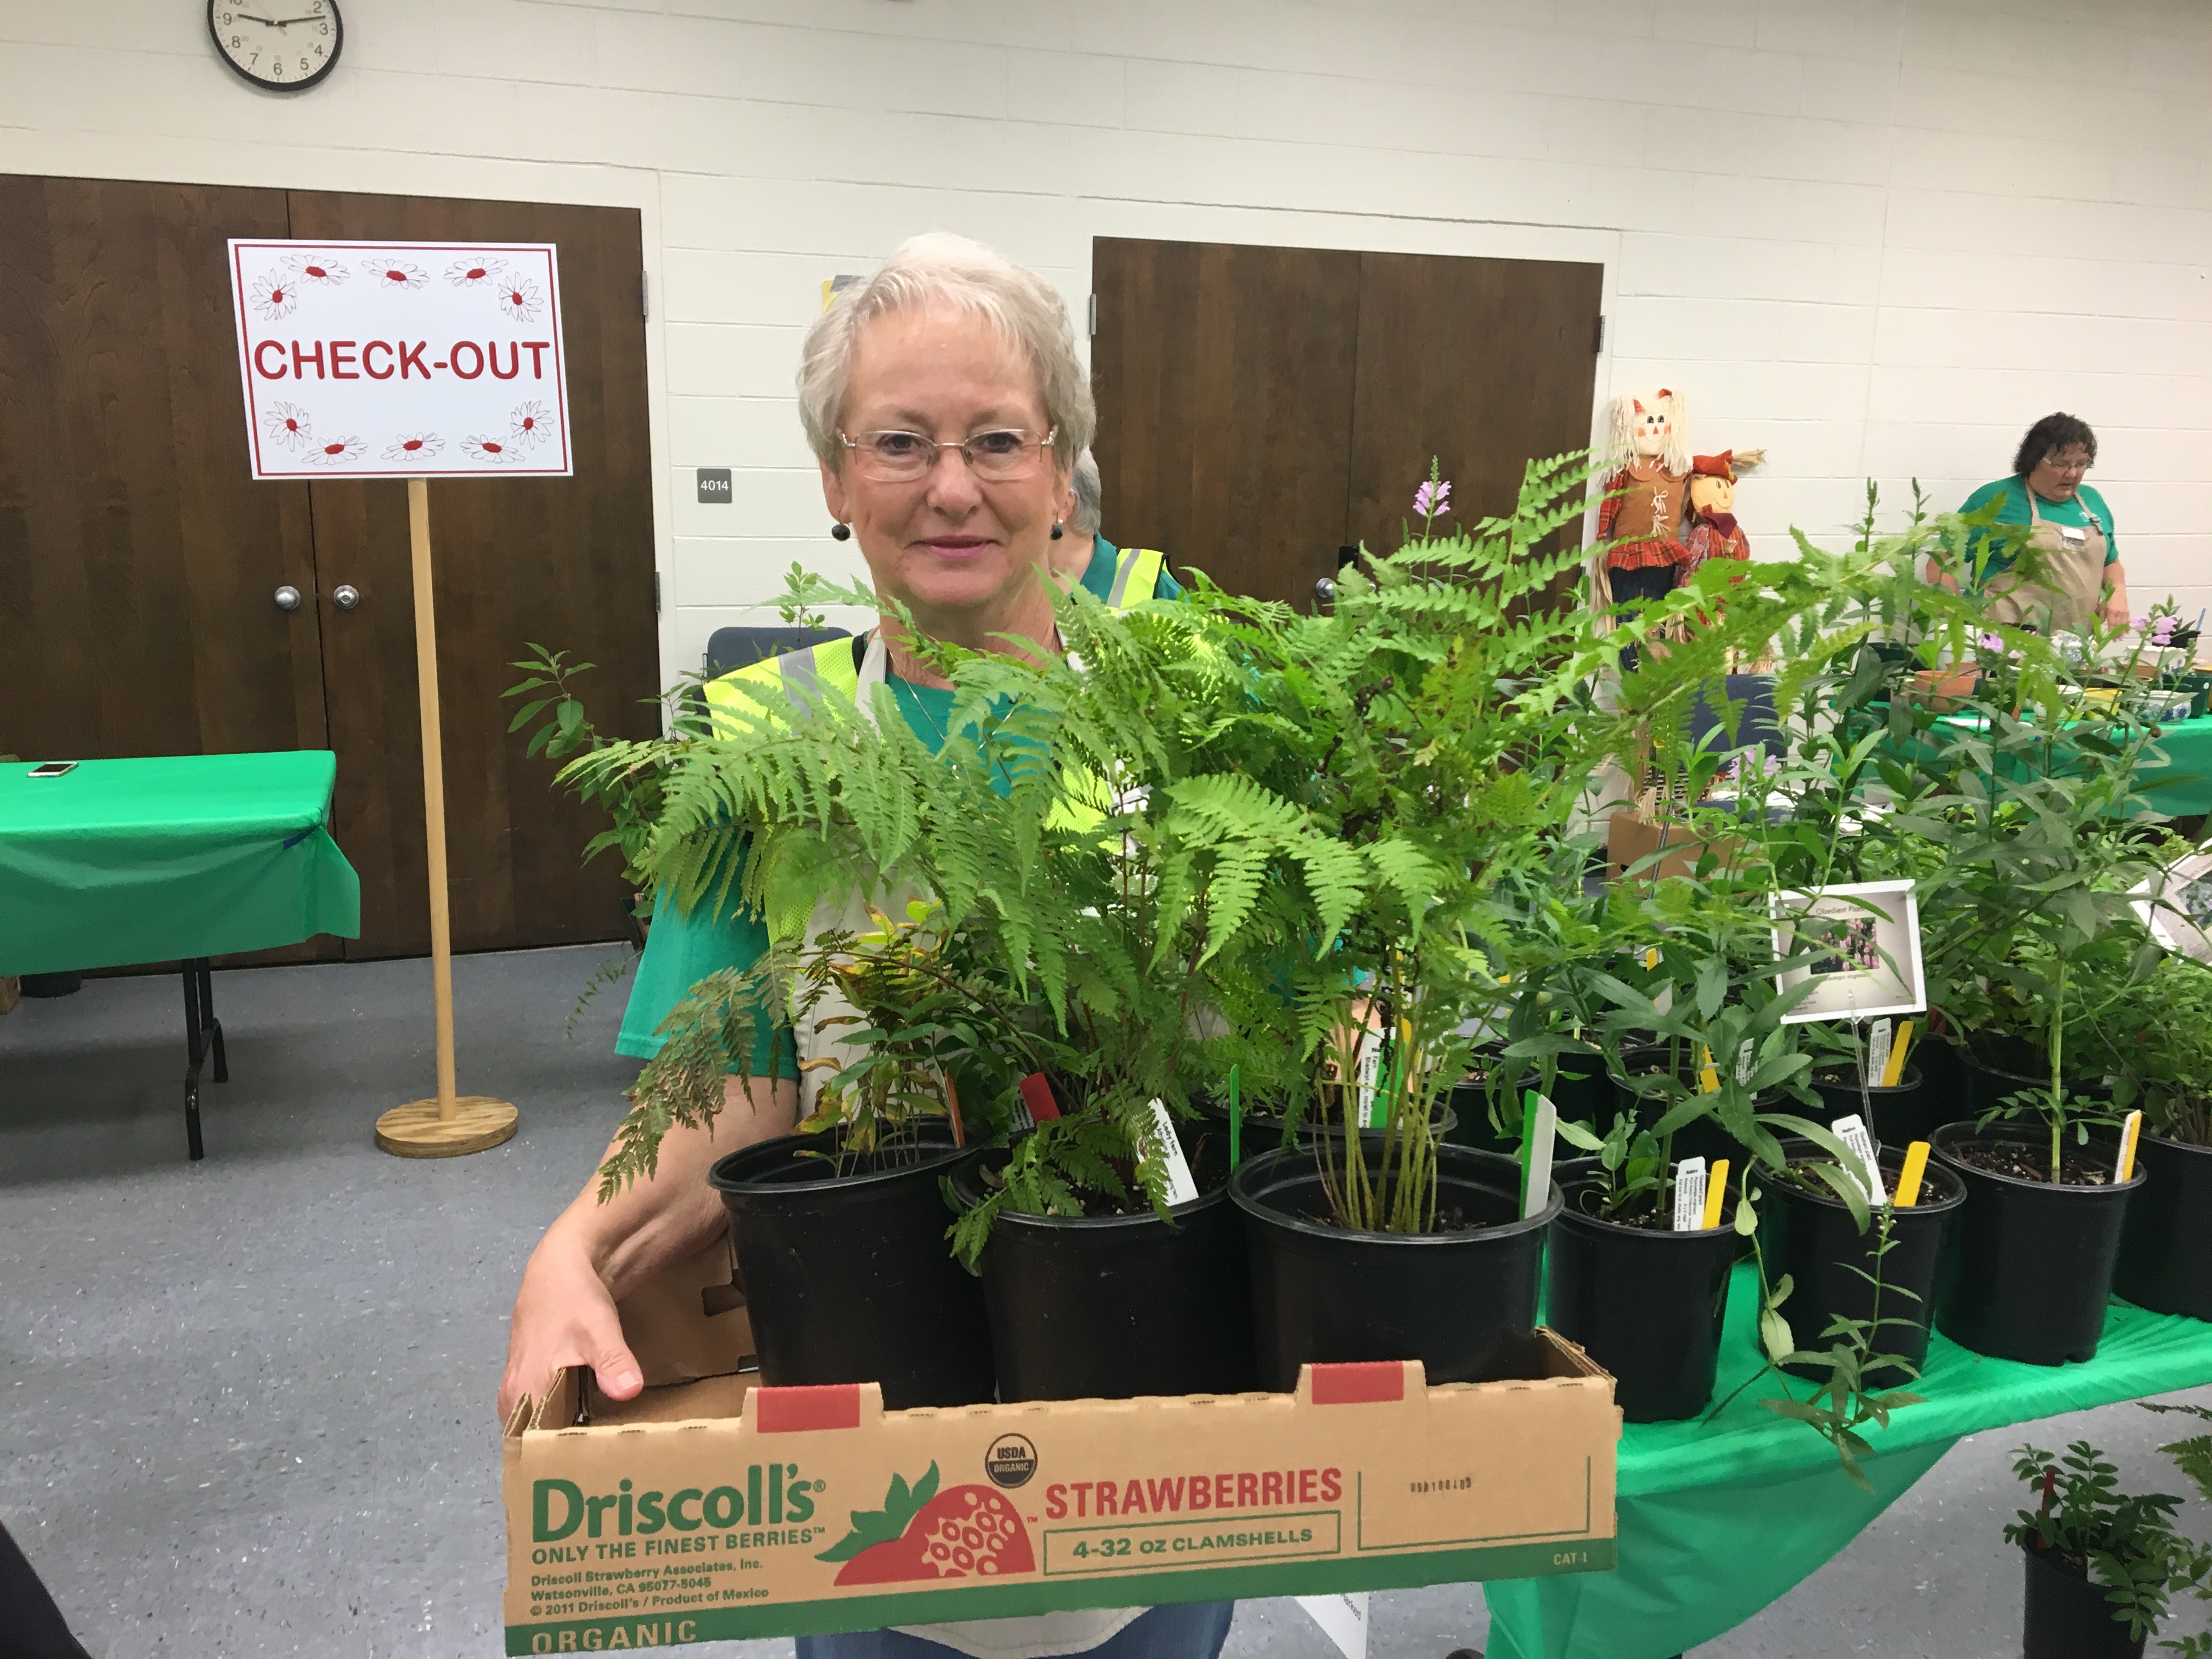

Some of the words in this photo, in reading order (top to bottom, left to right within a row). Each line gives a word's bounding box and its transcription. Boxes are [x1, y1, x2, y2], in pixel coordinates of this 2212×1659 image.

[313, 1, 321, 14] 2
[222, 12, 232, 26] 9
[319, 22, 329, 36] 3
[231, 35, 241, 49] 8
[314, 44, 323, 57] 4
[250, 52, 259, 65] 7
[300, 58, 309, 71] 5
[273, 63, 283, 76] 6
[254, 340, 550, 380] CHECK-OUT
[701, 480, 729, 490] 4014
[1163, 1121, 1172, 1140] Lady
[997, 1446, 1026, 1459] USDA
[994, 1462, 1029, 1473] ORGANIC
[1045, 1467, 1343, 1520] STRAWBERRIES
[532, 1545, 589, 1565] ONLY
[595, 1541, 636, 1559] THE
[645, 1535, 719, 1556] FINEST
[1073, 1537, 1131, 1559] 4-32
[1139, 1539, 1167, 1554] OZ
[1172, 1528, 1313, 1552] CLAMSHELLS
[1553, 1552, 1577, 1566] CAT
[531, 1572, 582, 1587] Driscoll
[585, 1567, 659, 1583] Strawberry
[663, 1562, 737, 1576] Associates,
[740, 1558, 763, 1570] Inc.
[531, 1585, 613, 1601] Watsonville,
[616, 1583, 635, 1594] CA
[638, 1576, 712, 1593] 95077-5045
[545, 1602, 574, 1616] 2011
[578, 1598, 639, 1613] Driscoll's
[652, 1592, 703, 1606] Product
[706, 1590, 720, 1601] of
[723, 1588, 769, 1600] Mexico
[531, 1619, 697, 1656] ORGANIC
